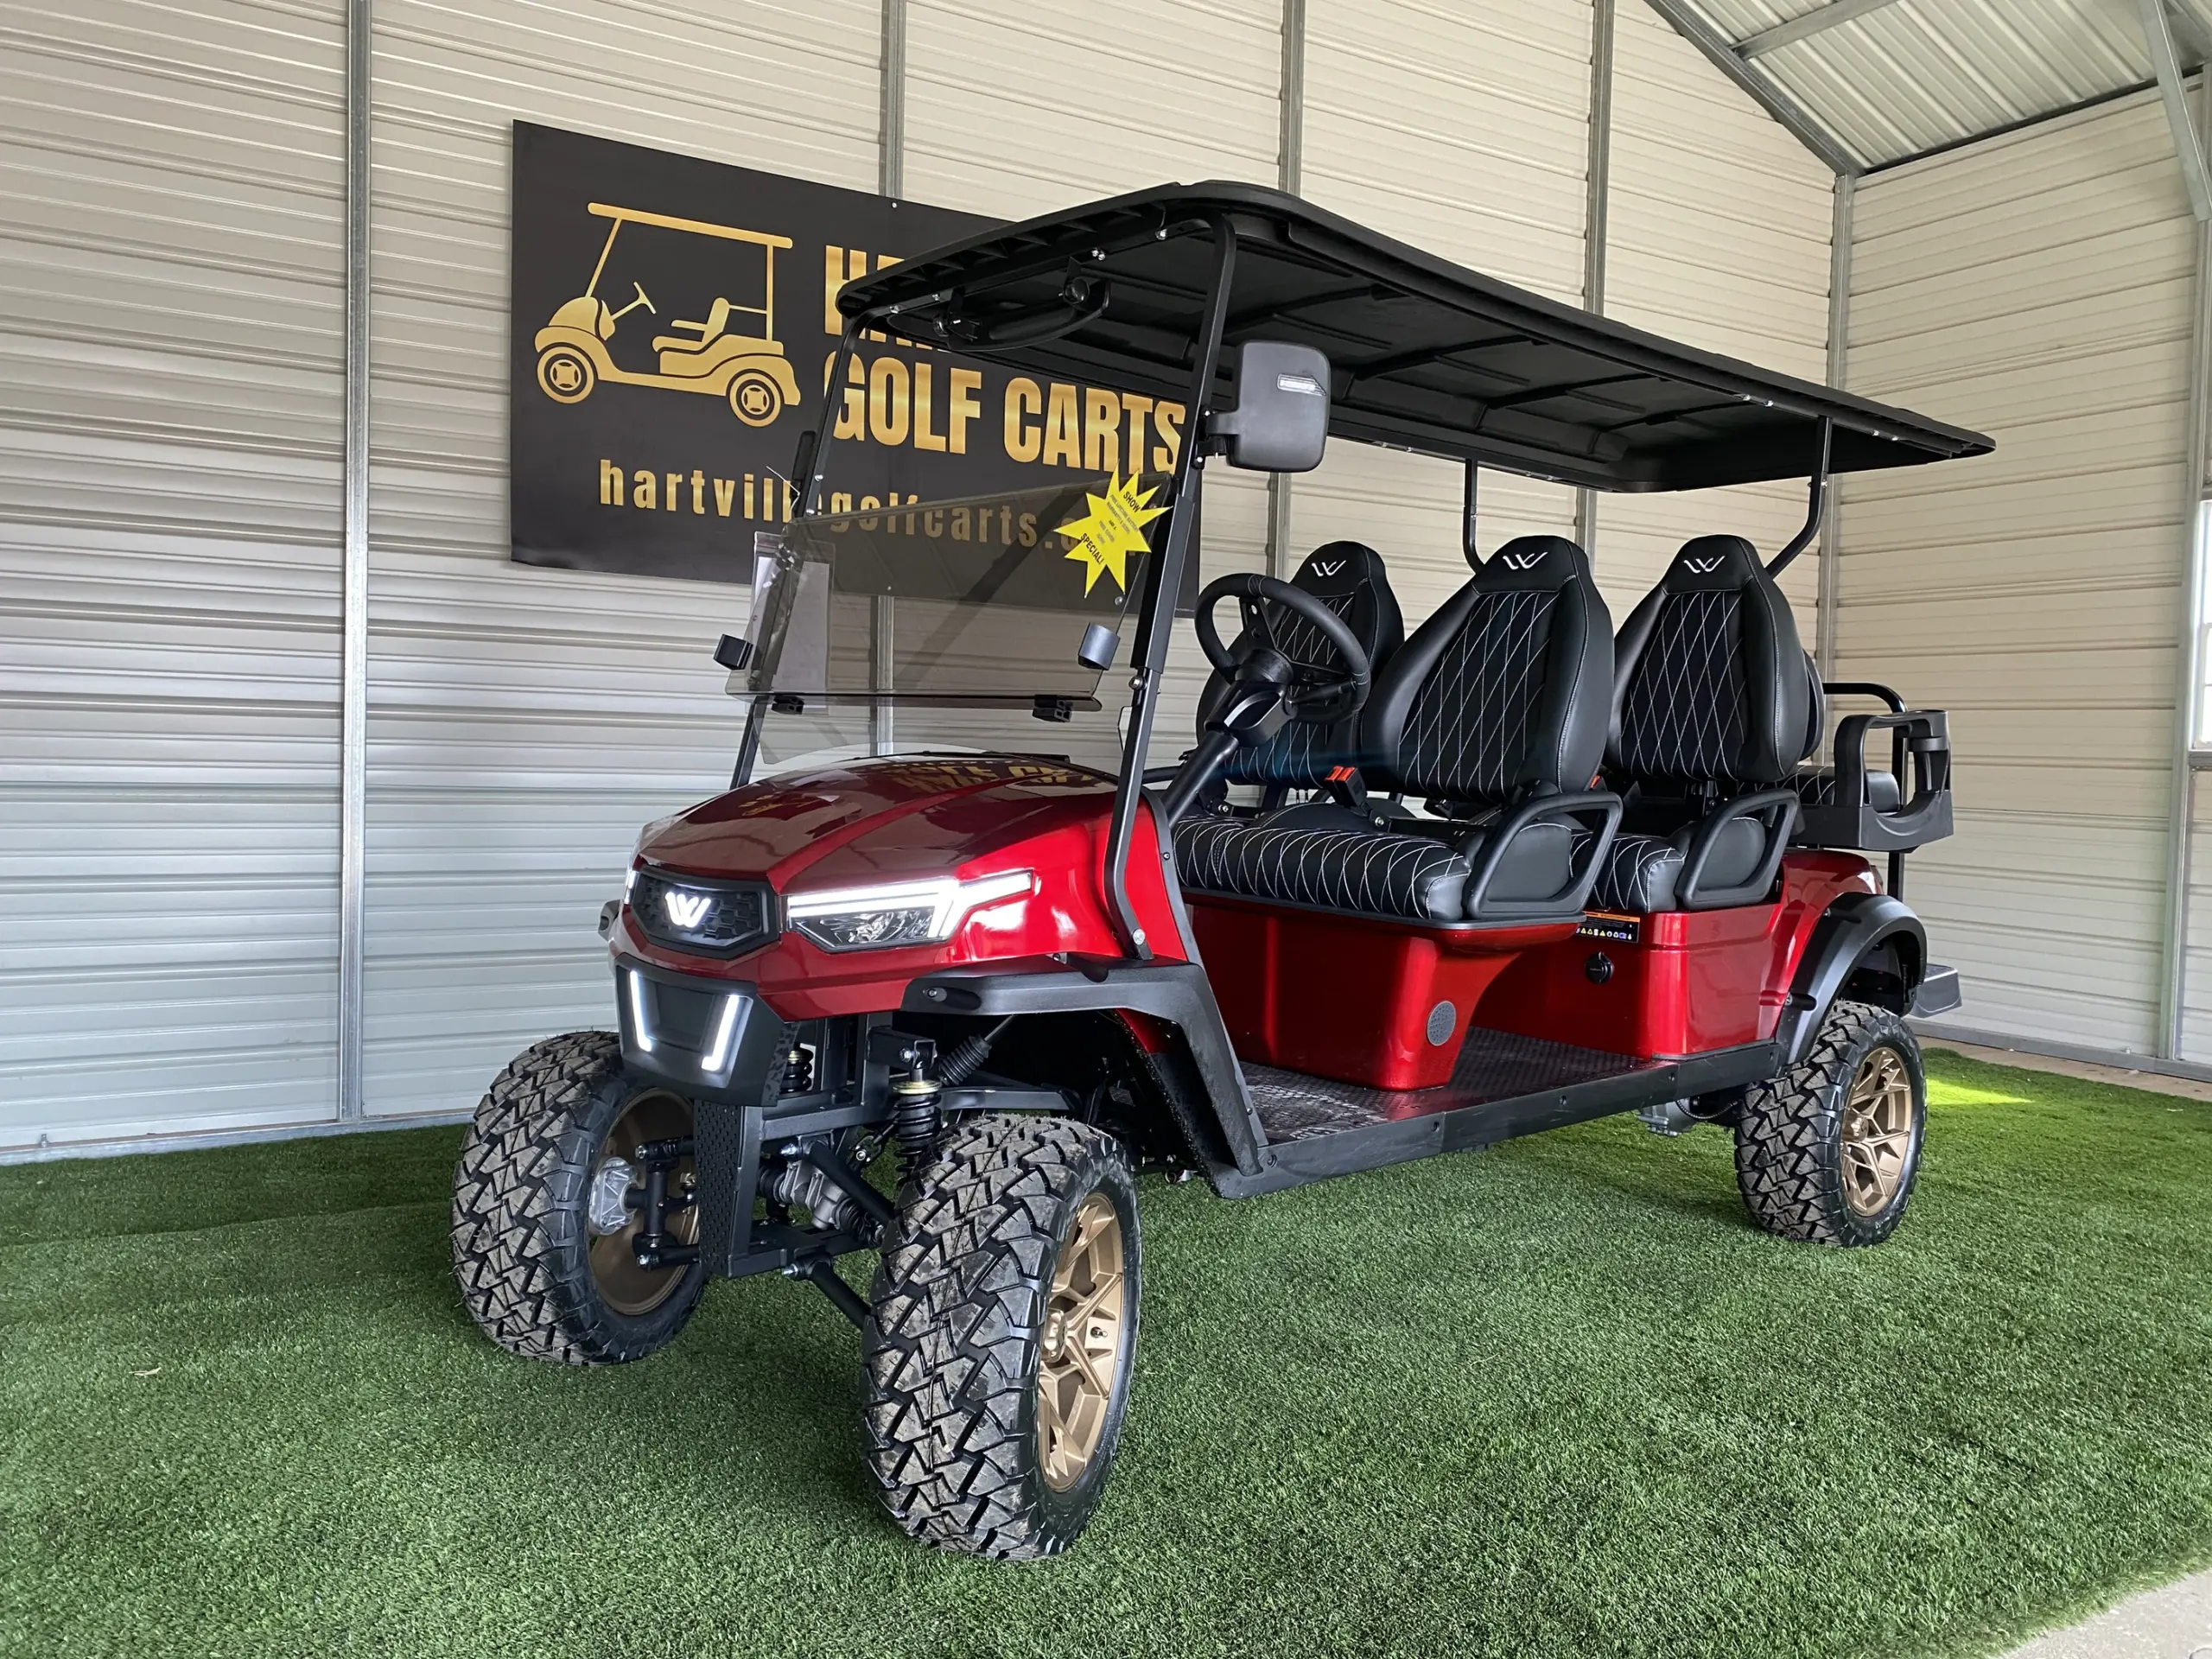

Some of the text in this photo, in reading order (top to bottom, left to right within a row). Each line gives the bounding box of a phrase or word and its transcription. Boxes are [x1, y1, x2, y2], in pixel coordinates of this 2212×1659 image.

[823, 350, 1186, 475] GOLF CARTS
[1123, 491, 1141, 513] SHOW
[1080, 532, 1105, 565] SPECIAL!
